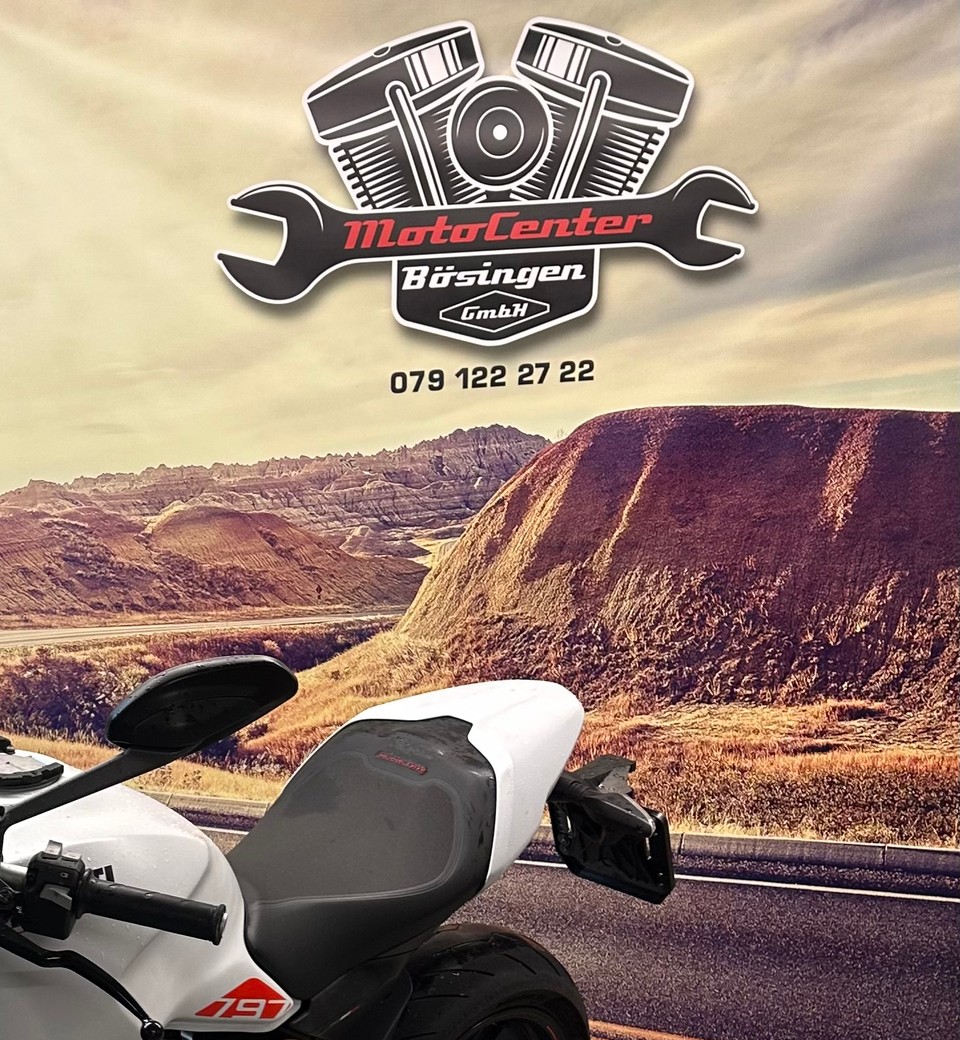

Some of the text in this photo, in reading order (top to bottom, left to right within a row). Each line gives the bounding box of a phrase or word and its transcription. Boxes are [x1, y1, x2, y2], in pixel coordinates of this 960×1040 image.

[343, 208, 653, 250] MotoCenter
[401, 261, 587, 290] Bösingen
[460, 303, 529, 321] GmbH
[390, 360, 595, 394] 079 122 27 22
[212, 998, 292, 1019] 797
